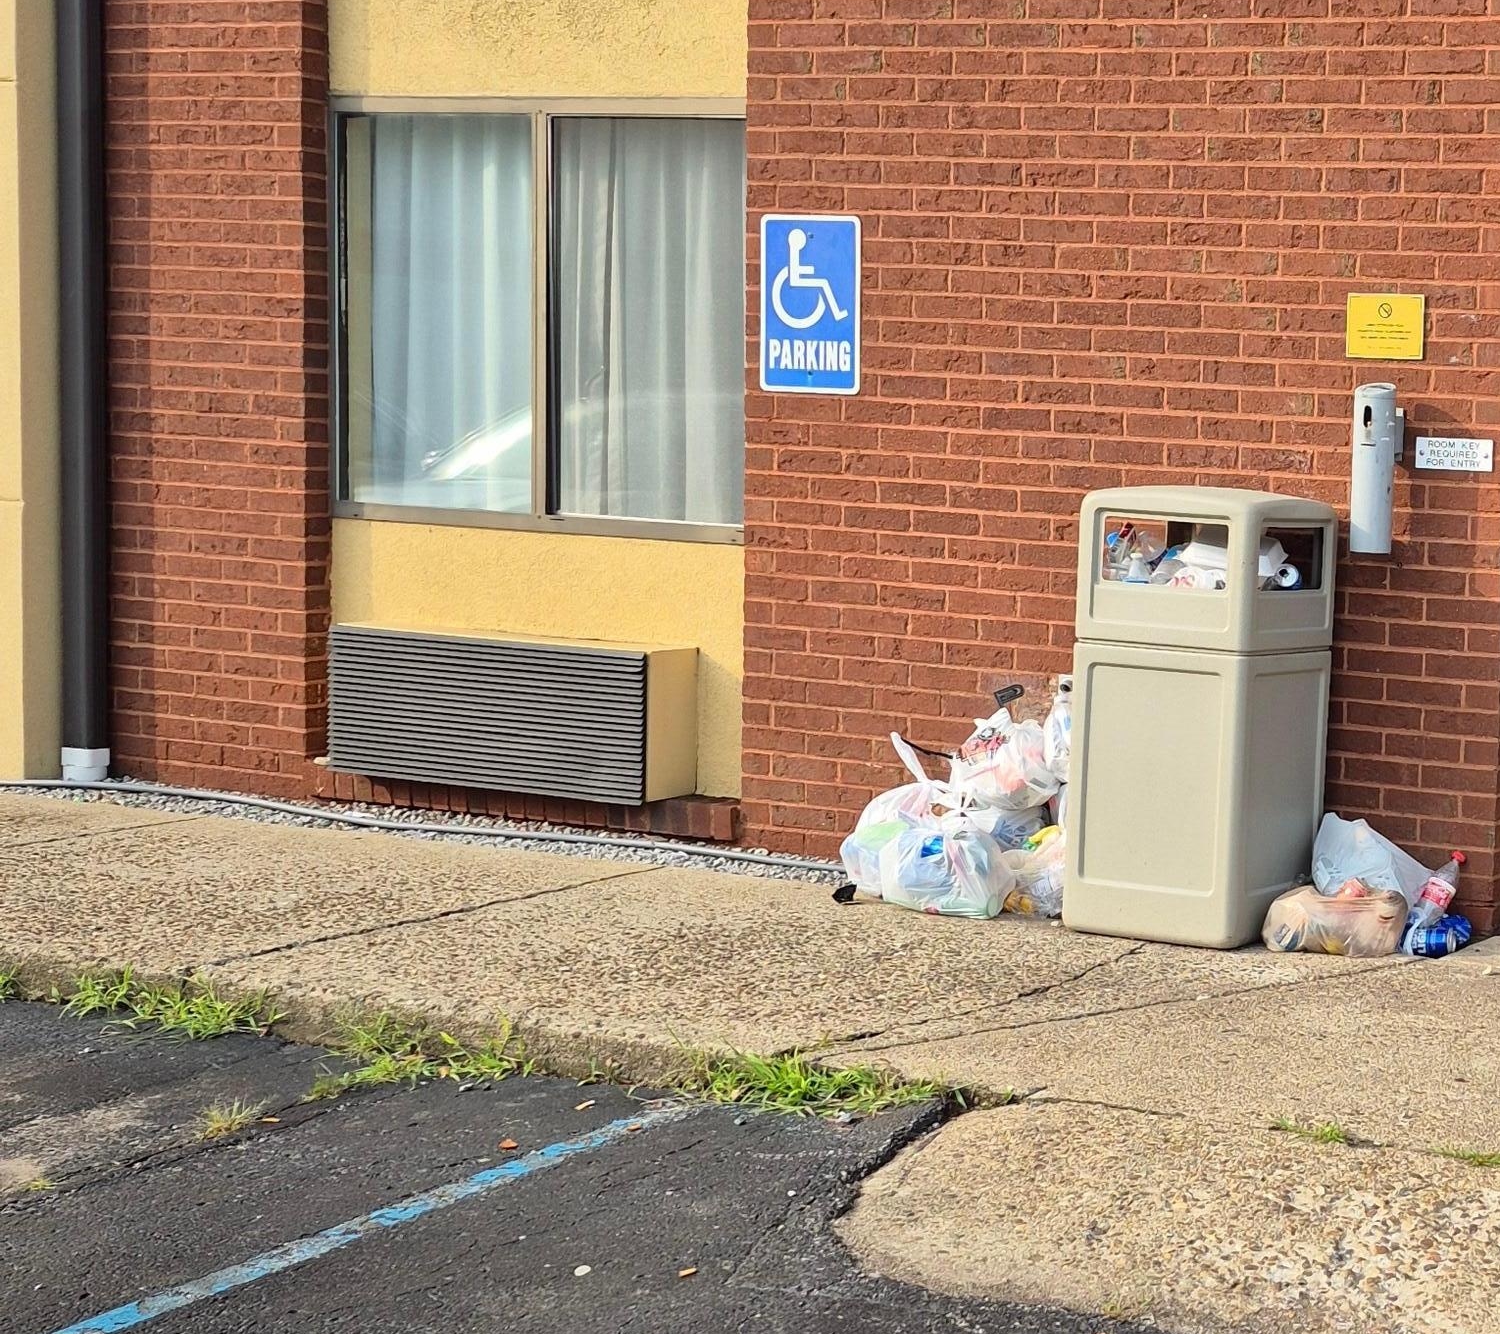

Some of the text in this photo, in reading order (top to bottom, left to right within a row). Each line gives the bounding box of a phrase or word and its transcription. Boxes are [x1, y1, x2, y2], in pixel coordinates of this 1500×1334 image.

[768, 339, 851, 372] PARKING
[1428, 440, 1480, 450] ROOM KEY
[1429, 450, 1478, 459] REQUIRED
[1426, 458, 1444, 466] FOR
